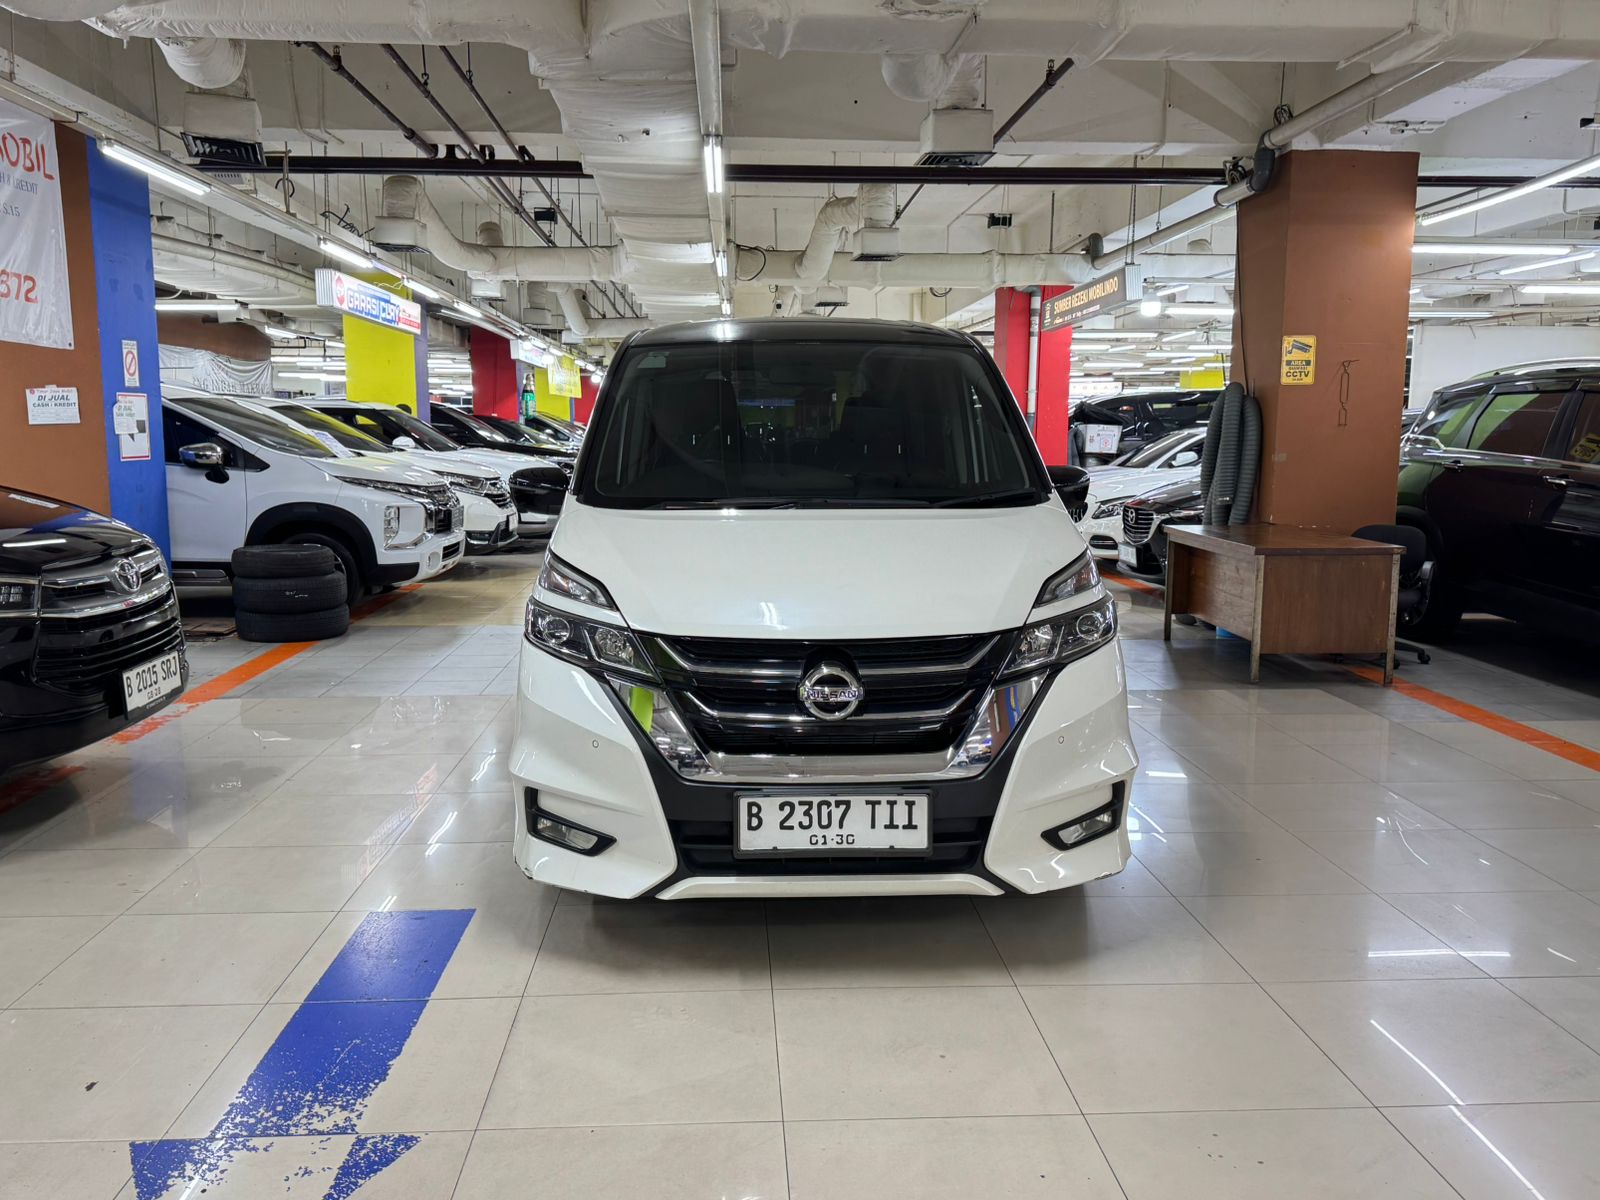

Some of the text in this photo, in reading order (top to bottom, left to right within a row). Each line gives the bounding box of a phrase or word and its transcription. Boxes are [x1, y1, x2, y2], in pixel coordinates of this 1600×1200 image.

[0, 132, 55, 180] OBIL
[347, 289, 380, 319] GARASI
[1054, 295, 1072, 315] SUMBER
[1072, 288, 1089, 308] REZEKI
[1089, 276, 1119, 301] MOBILINDO
[125, 656, 178, 698] B 2015 SRJ
[806, 689, 857, 699] NISSAN
[747, 799, 918, 831] B 2307 TII
